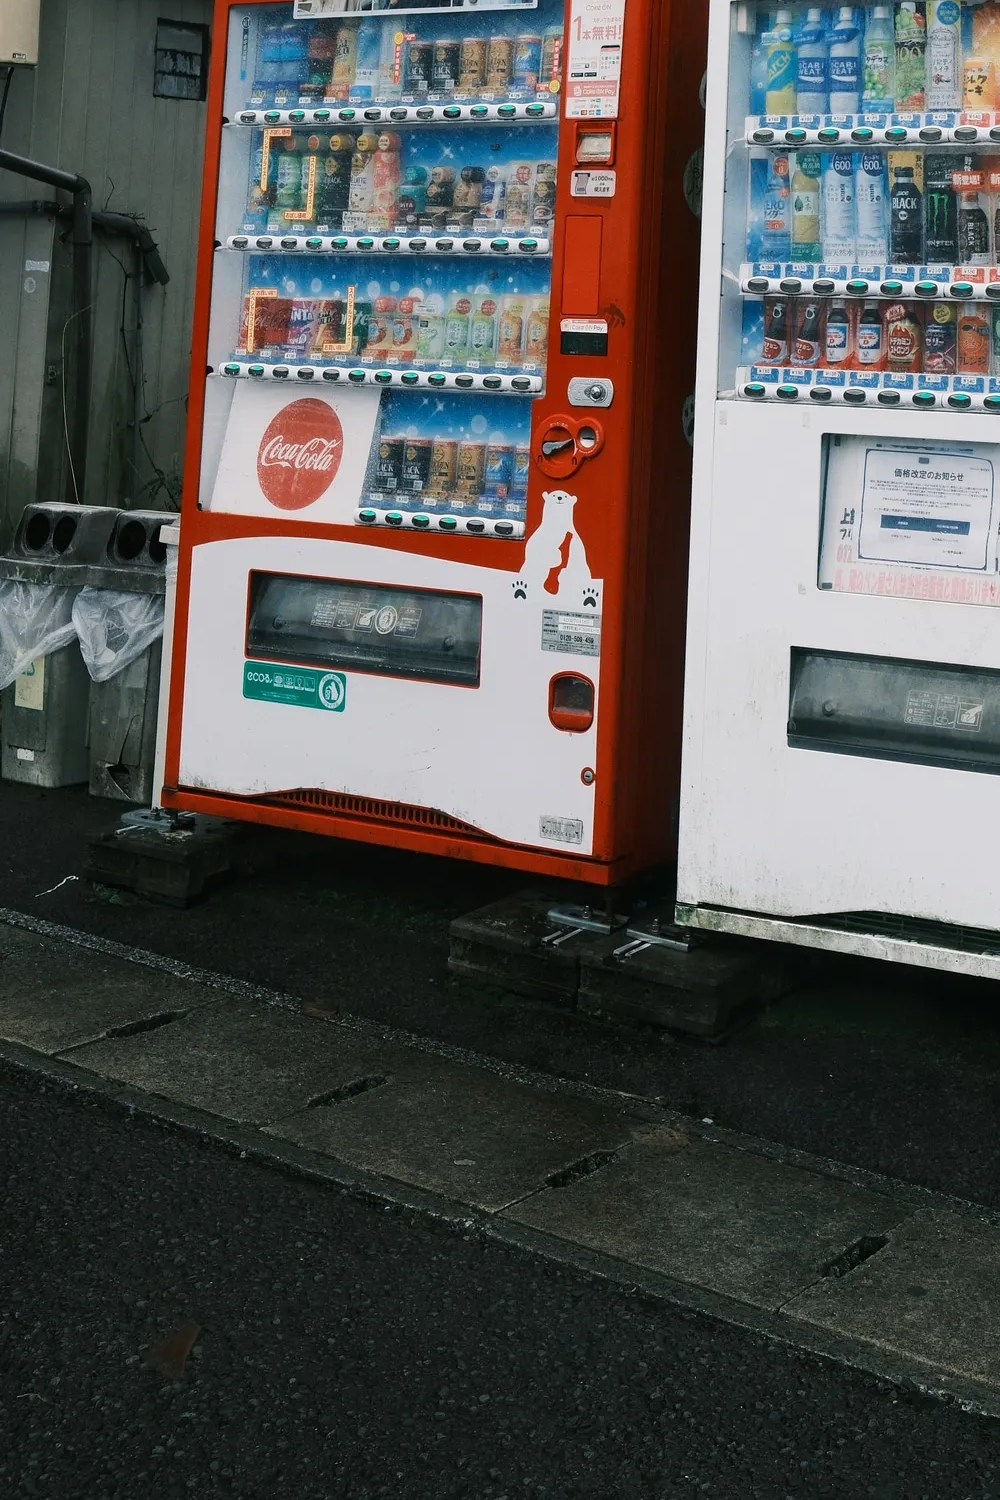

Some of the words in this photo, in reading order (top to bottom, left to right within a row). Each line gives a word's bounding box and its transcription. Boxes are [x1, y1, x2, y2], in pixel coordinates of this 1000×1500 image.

[834, 160, 851, 170] 600
[863, 160, 880, 170] 600
[952, 173, 980, 185] 新登場!
[892, 197, 917, 209] BLACK
[260, 434, 342, 471] Coca-Cola
[894, 468, 965, 482] 価格改定のお知らせ
